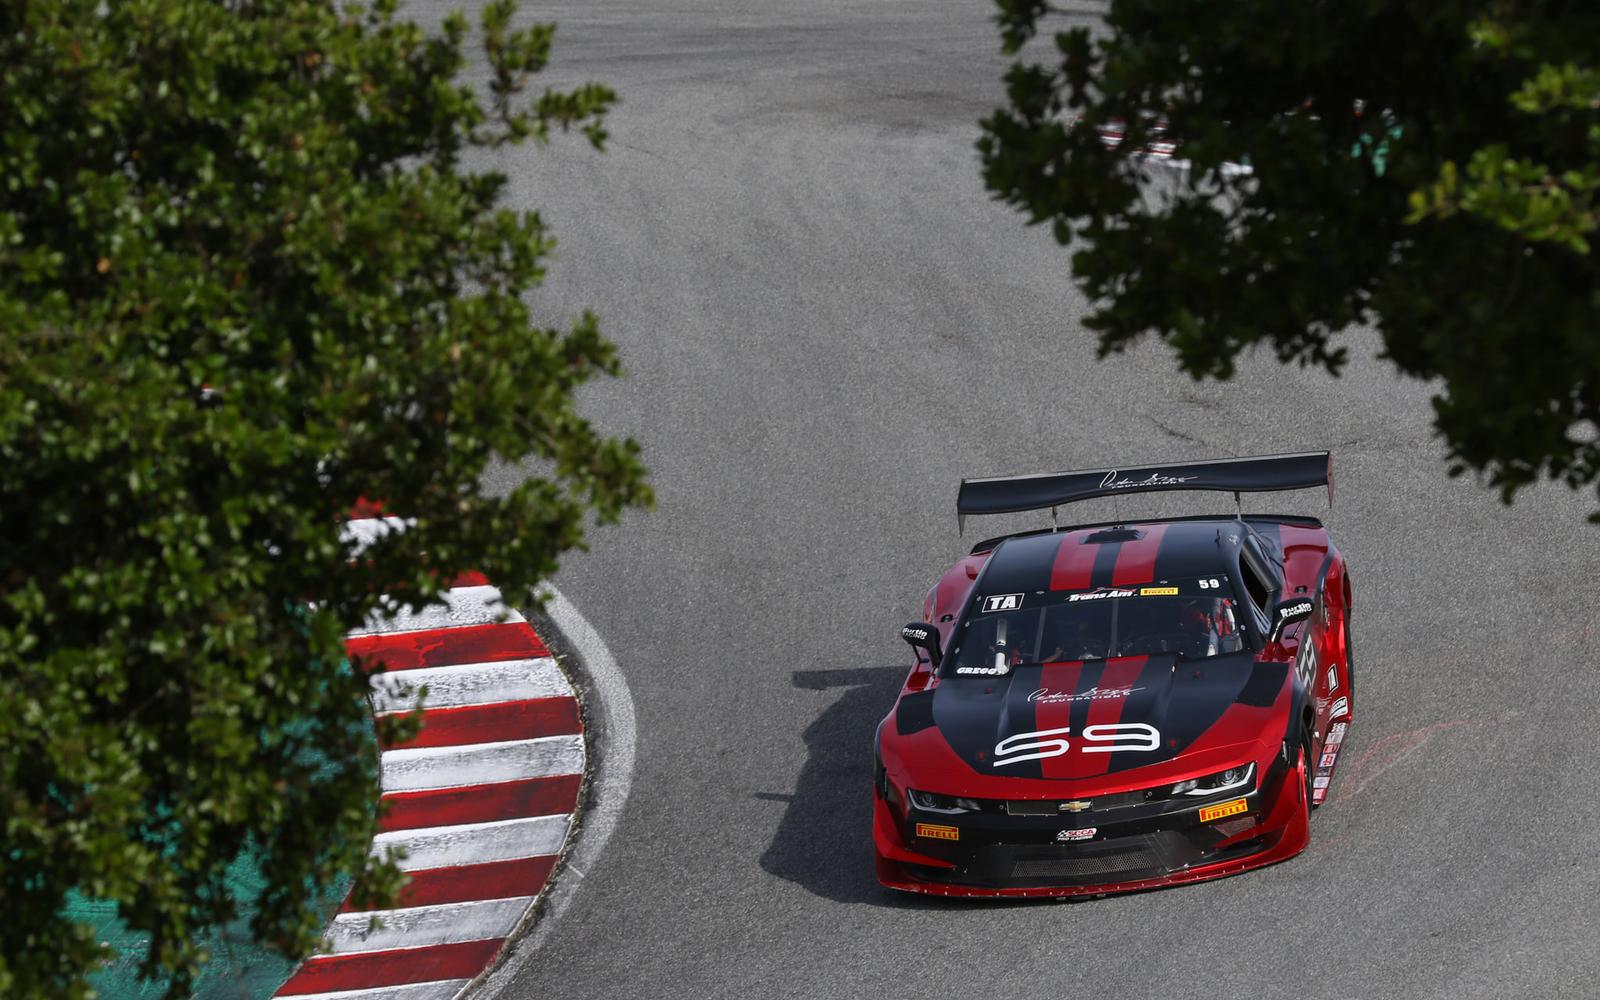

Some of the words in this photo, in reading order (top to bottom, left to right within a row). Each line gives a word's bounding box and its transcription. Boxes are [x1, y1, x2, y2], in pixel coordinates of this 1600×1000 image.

[1199, 579, 1219, 589] 59
[990, 595, 1016, 610] TA
[1069, 593, 1107, 602] Trans
[1042, 695, 1120, 703] FOUNDATION
[993, 723, 1160, 767] 59
[1201, 799, 1246, 820] PIRELLI
[918, 824, 958, 839] PIRELLI
